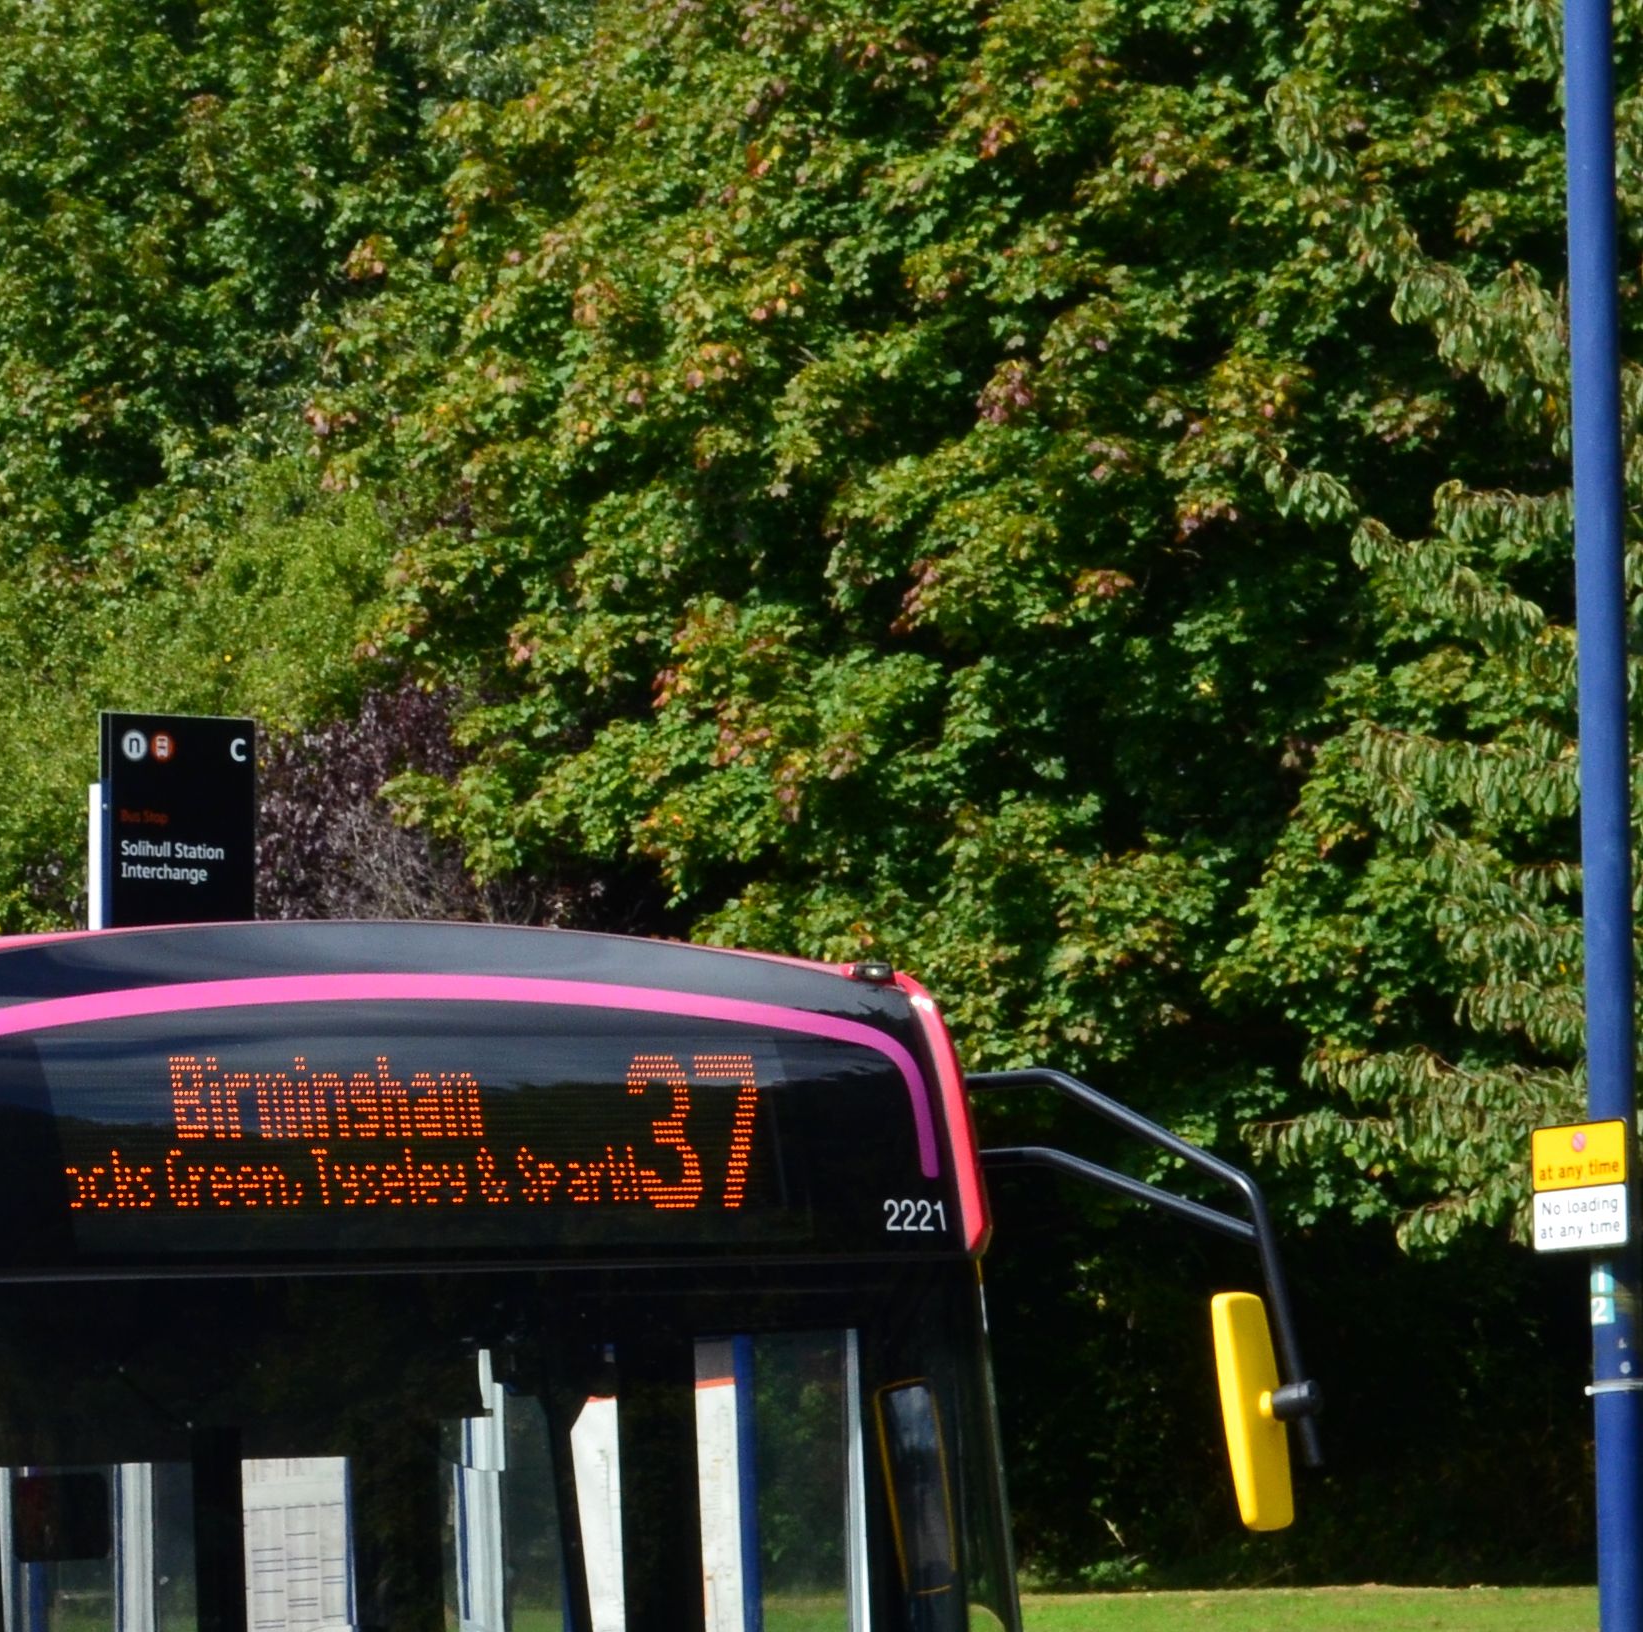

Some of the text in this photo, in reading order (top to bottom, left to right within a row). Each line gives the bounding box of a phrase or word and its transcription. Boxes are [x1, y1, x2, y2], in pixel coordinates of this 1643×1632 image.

[230, 738, 246, 762] C
[120, 809, 168, 825] Bus Stop
[121, 839, 224, 860] Solihull Station
[121, 862, 207, 885] Interchange
[169, 1055, 483, 1138] Birmingham
[626, 1054, 758, 1209] 37
[311, 1147, 467, 1206] Tyseley
[475, 1146, 509, 1204] &
[1539, 1158, 1619, 1181] at any time
[883, 1199, 946, 1231] 2221
[1542, 1197, 1619, 1216] No loading
[1541, 1220, 1620, 1239] at any time
